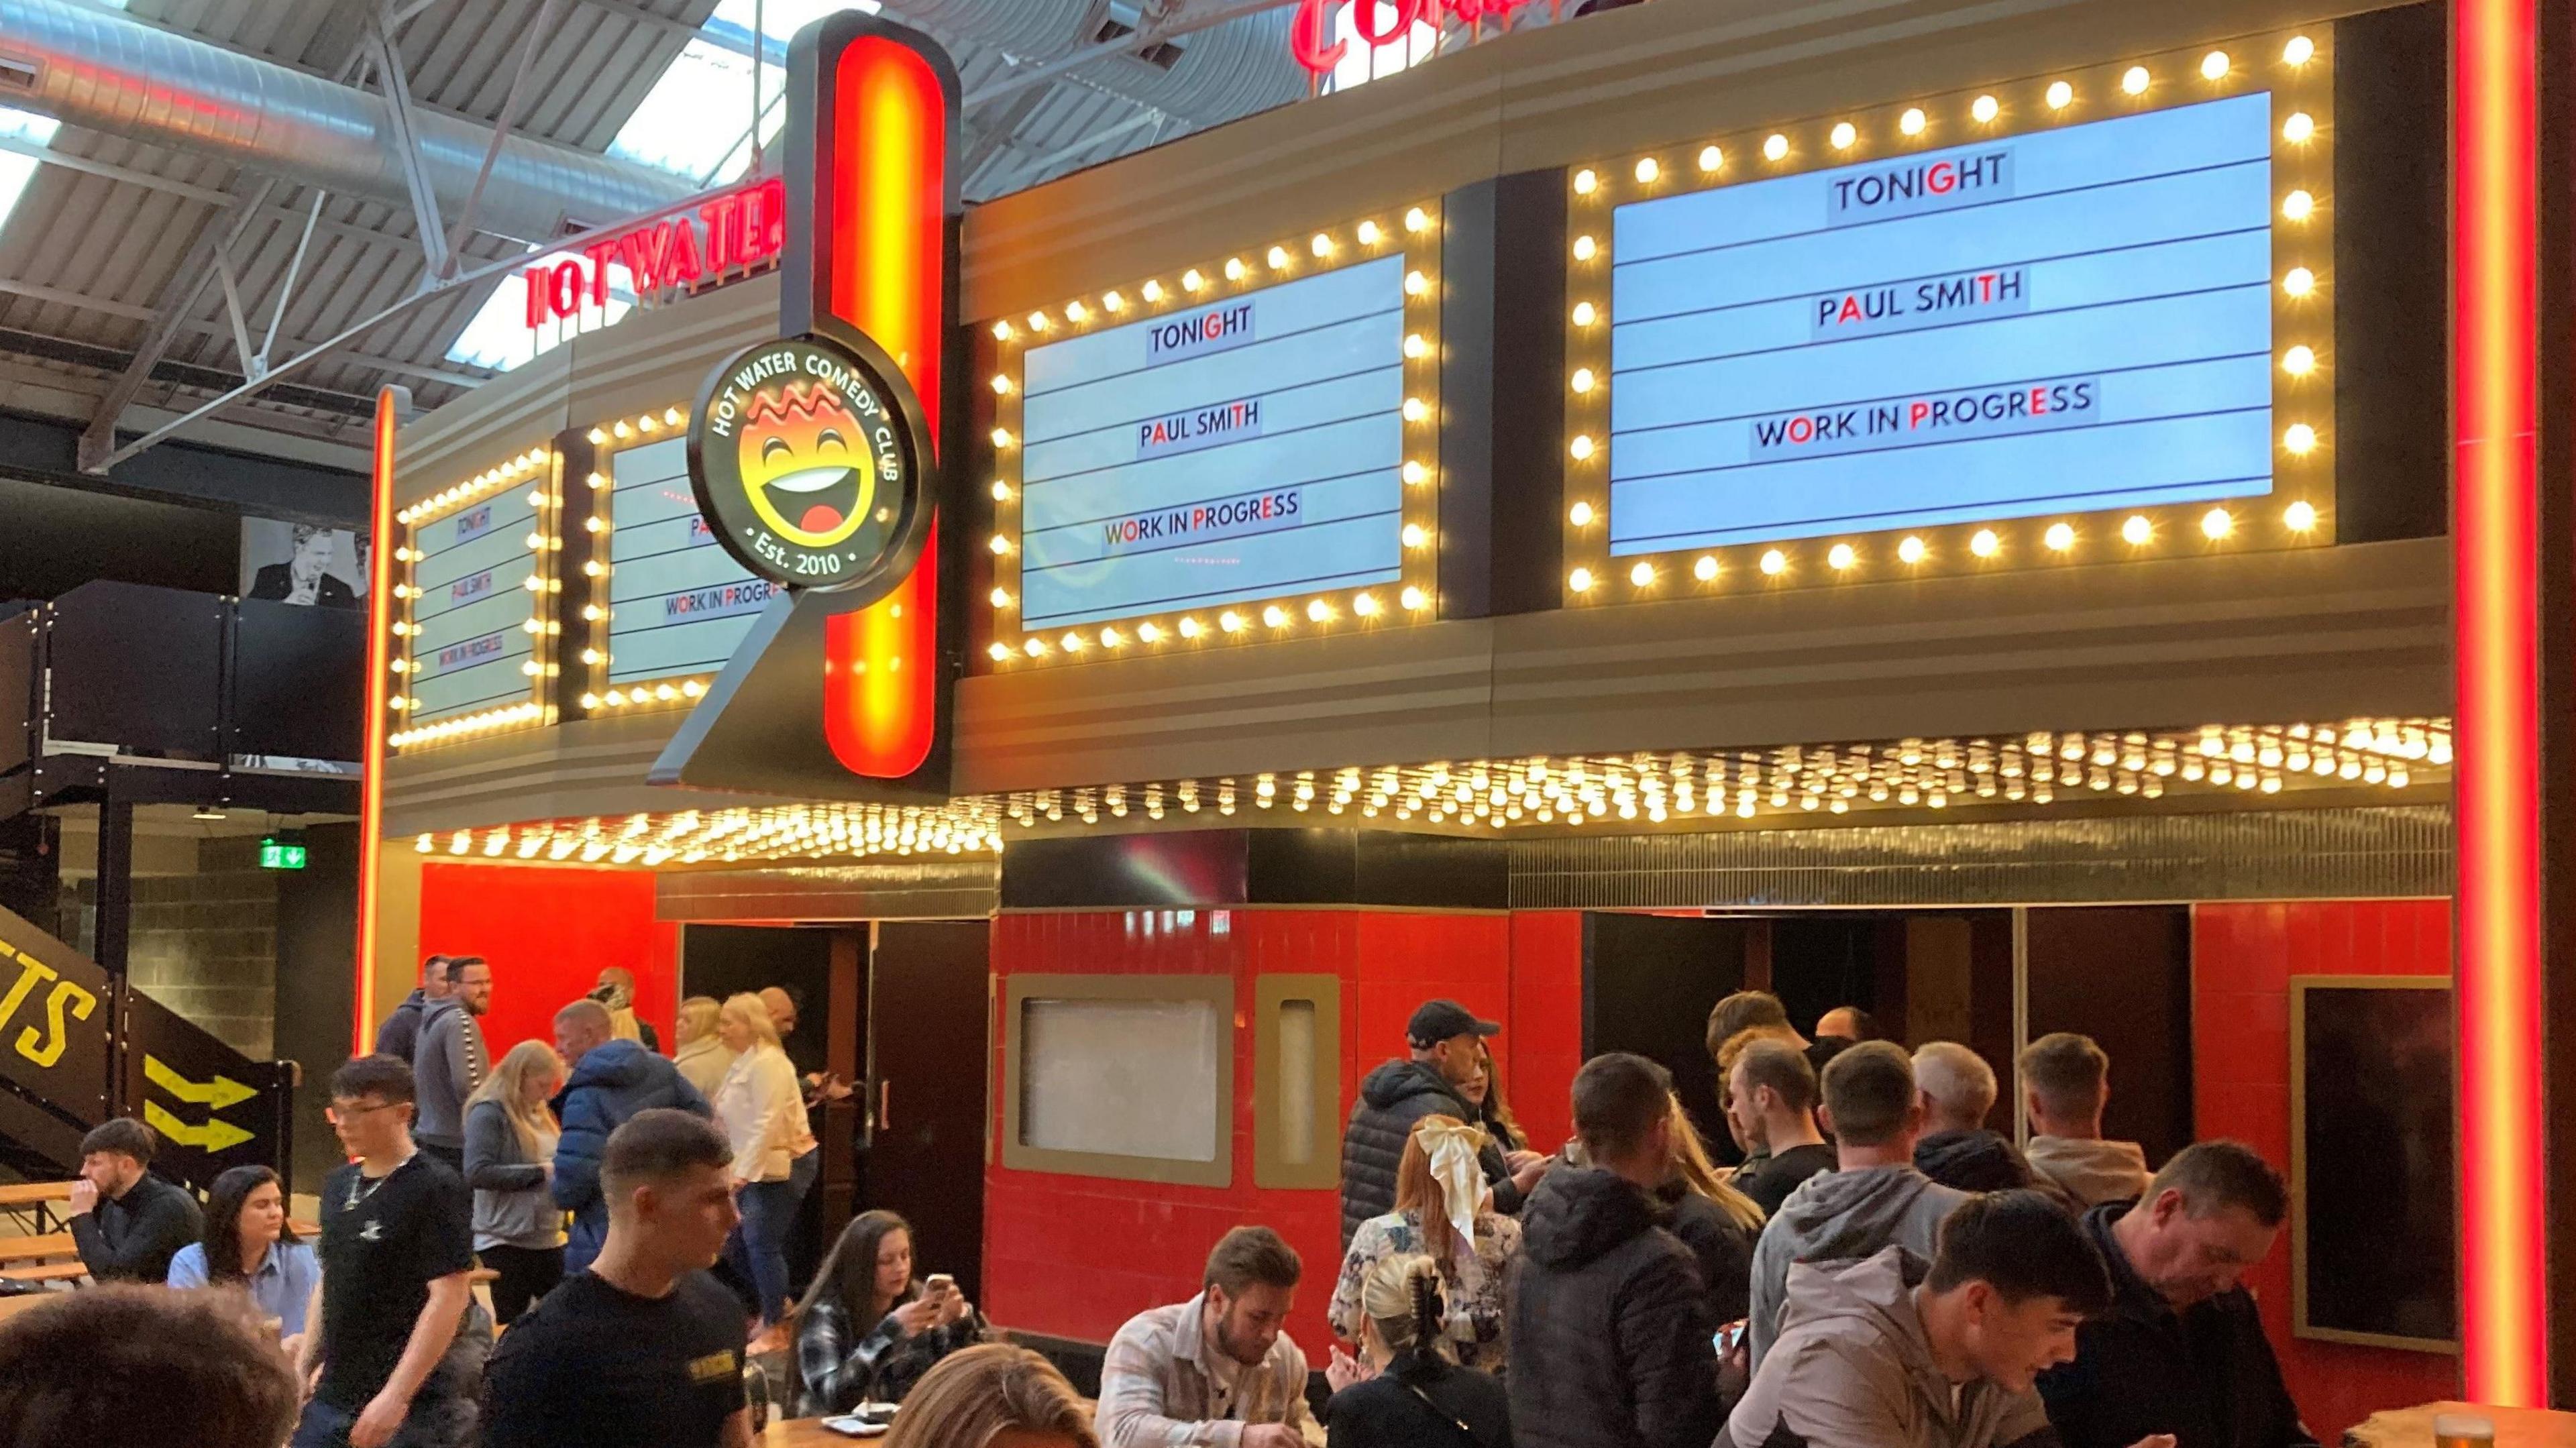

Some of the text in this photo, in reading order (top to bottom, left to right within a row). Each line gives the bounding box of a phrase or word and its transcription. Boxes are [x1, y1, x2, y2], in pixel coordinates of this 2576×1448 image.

[1834, 151, 2008, 211] TONIGHT
[620, 176, 786, 295] WATER
[1819, 270, 2023, 327] PAUL SMITH
[1150, 304, 1251, 353] TONIGHT
[712, 351, 898, 482] HOT WATER COMEDY CLUB
[1141, 401, 1258, 448] PAUL SMITH
[1757, 383, 2092, 447] WORK IN PROGRESS
[1105, 492, 1298, 545] WORK IN PROGRESS
[754, 533, 841, 575] Est. 2010
[666, 592, 706, 616] WORK
[708, 590, 722, 609] IN
[0, 940, 97, 1068] TS
